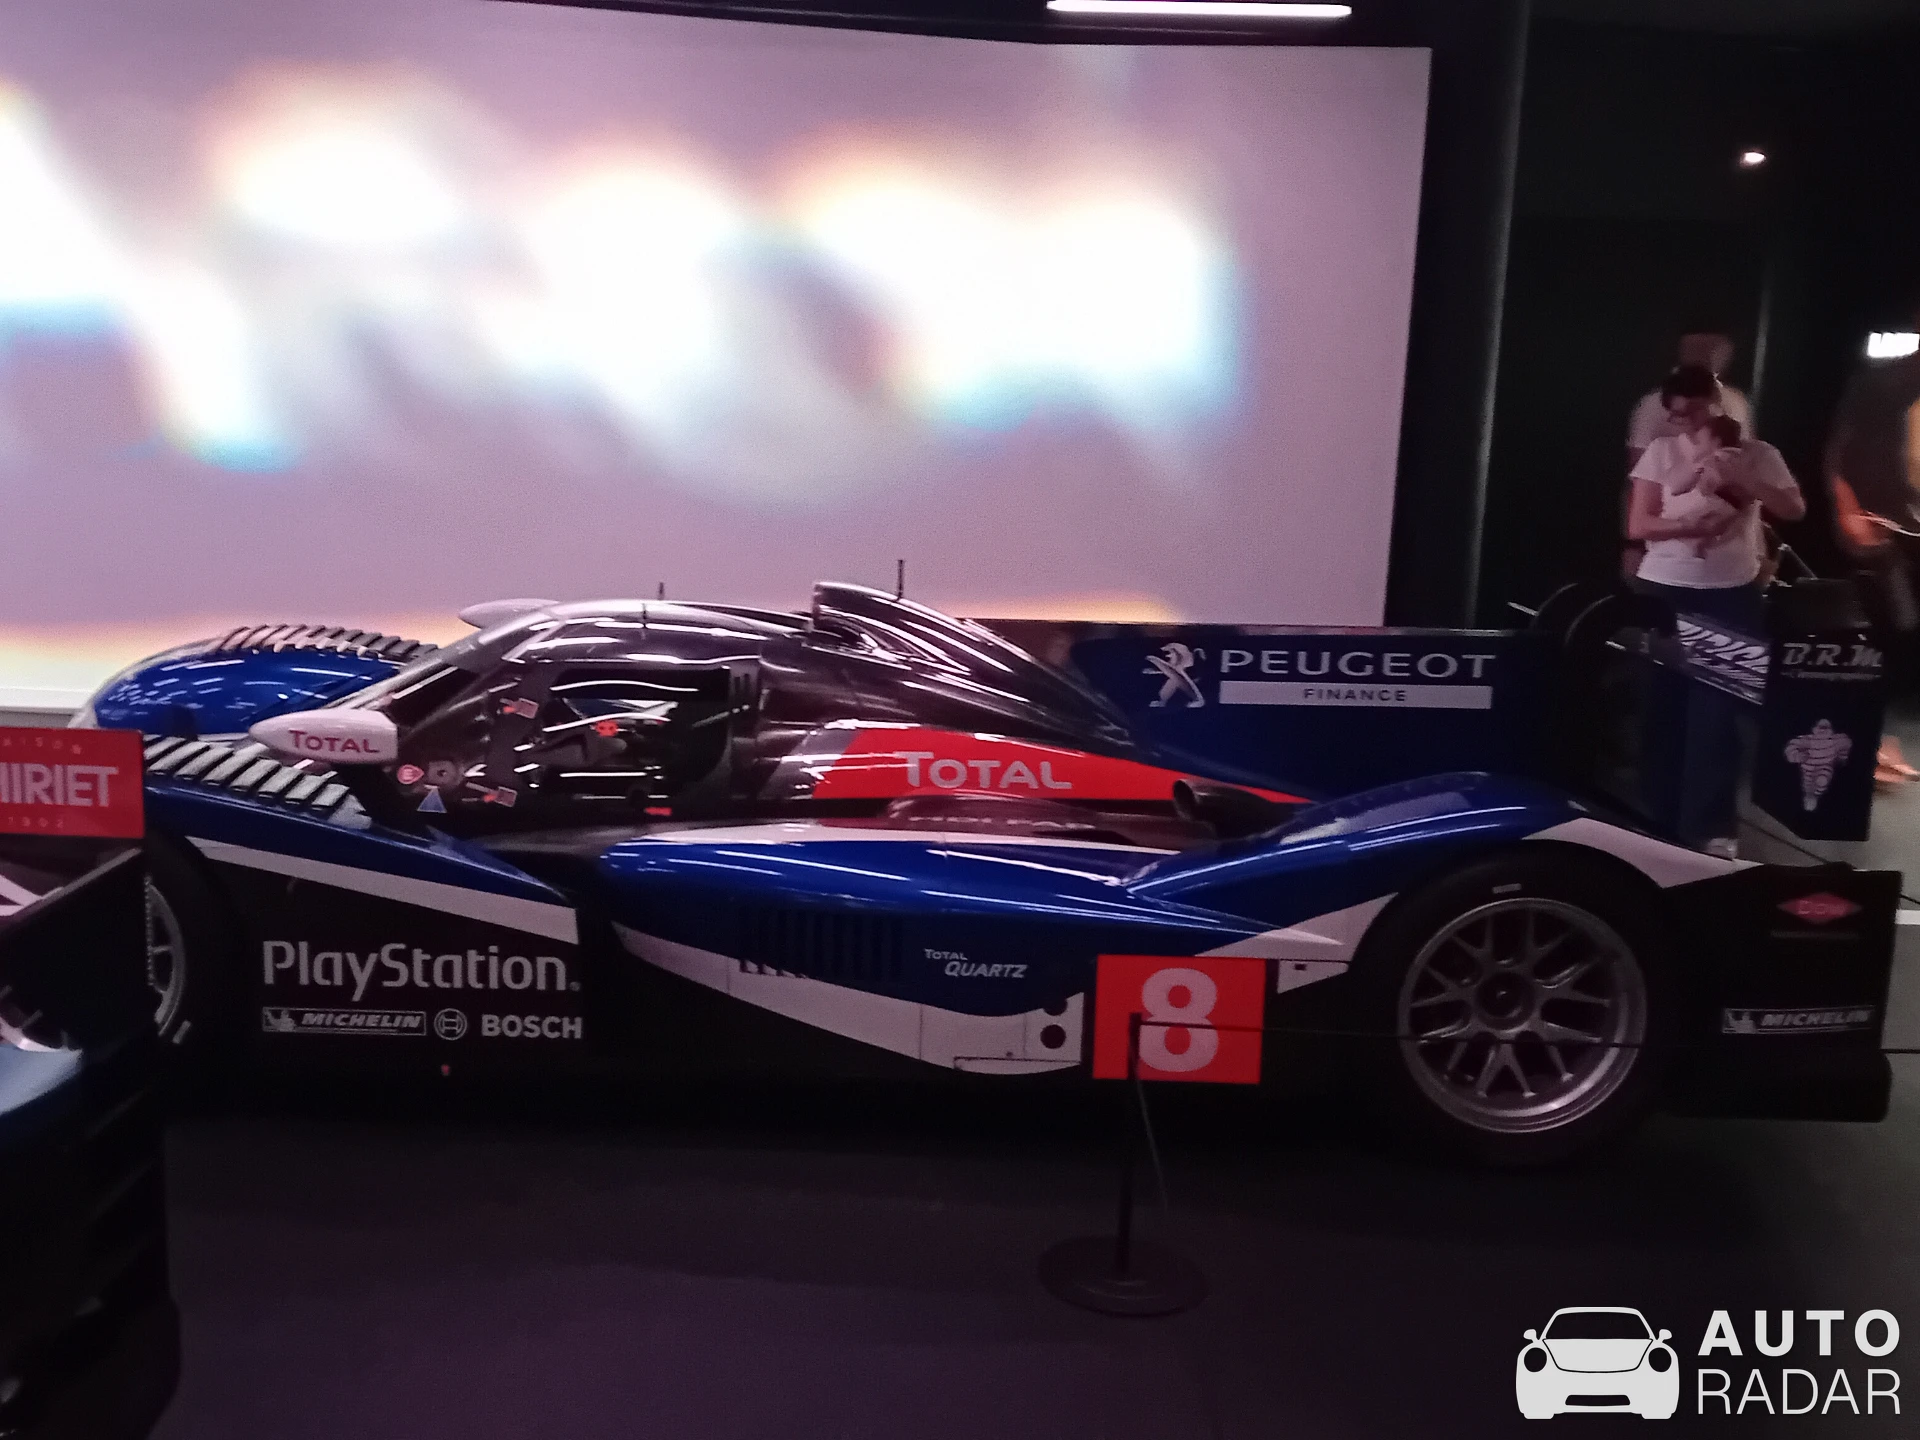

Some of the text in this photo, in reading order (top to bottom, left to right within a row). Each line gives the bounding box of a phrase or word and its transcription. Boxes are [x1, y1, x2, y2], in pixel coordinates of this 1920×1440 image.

[1220, 649, 1497, 678] PEUGEOT
[1303, 688, 1407, 702] FINANCE
[288, 729, 380, 753] TOTAL
[893, 751, 1073, 789] TOTAL
[924, 948, 968, 961] TOTAL
[263, 940, 567, 1001] PlayStation
[944, 961, 1028, 978] QUARTZ
[301, 1012, 421, 1029] MICHELIN
[481, 1014, 583, 1039] BOSCH
[1138, 968, 1219, 1072] 8
